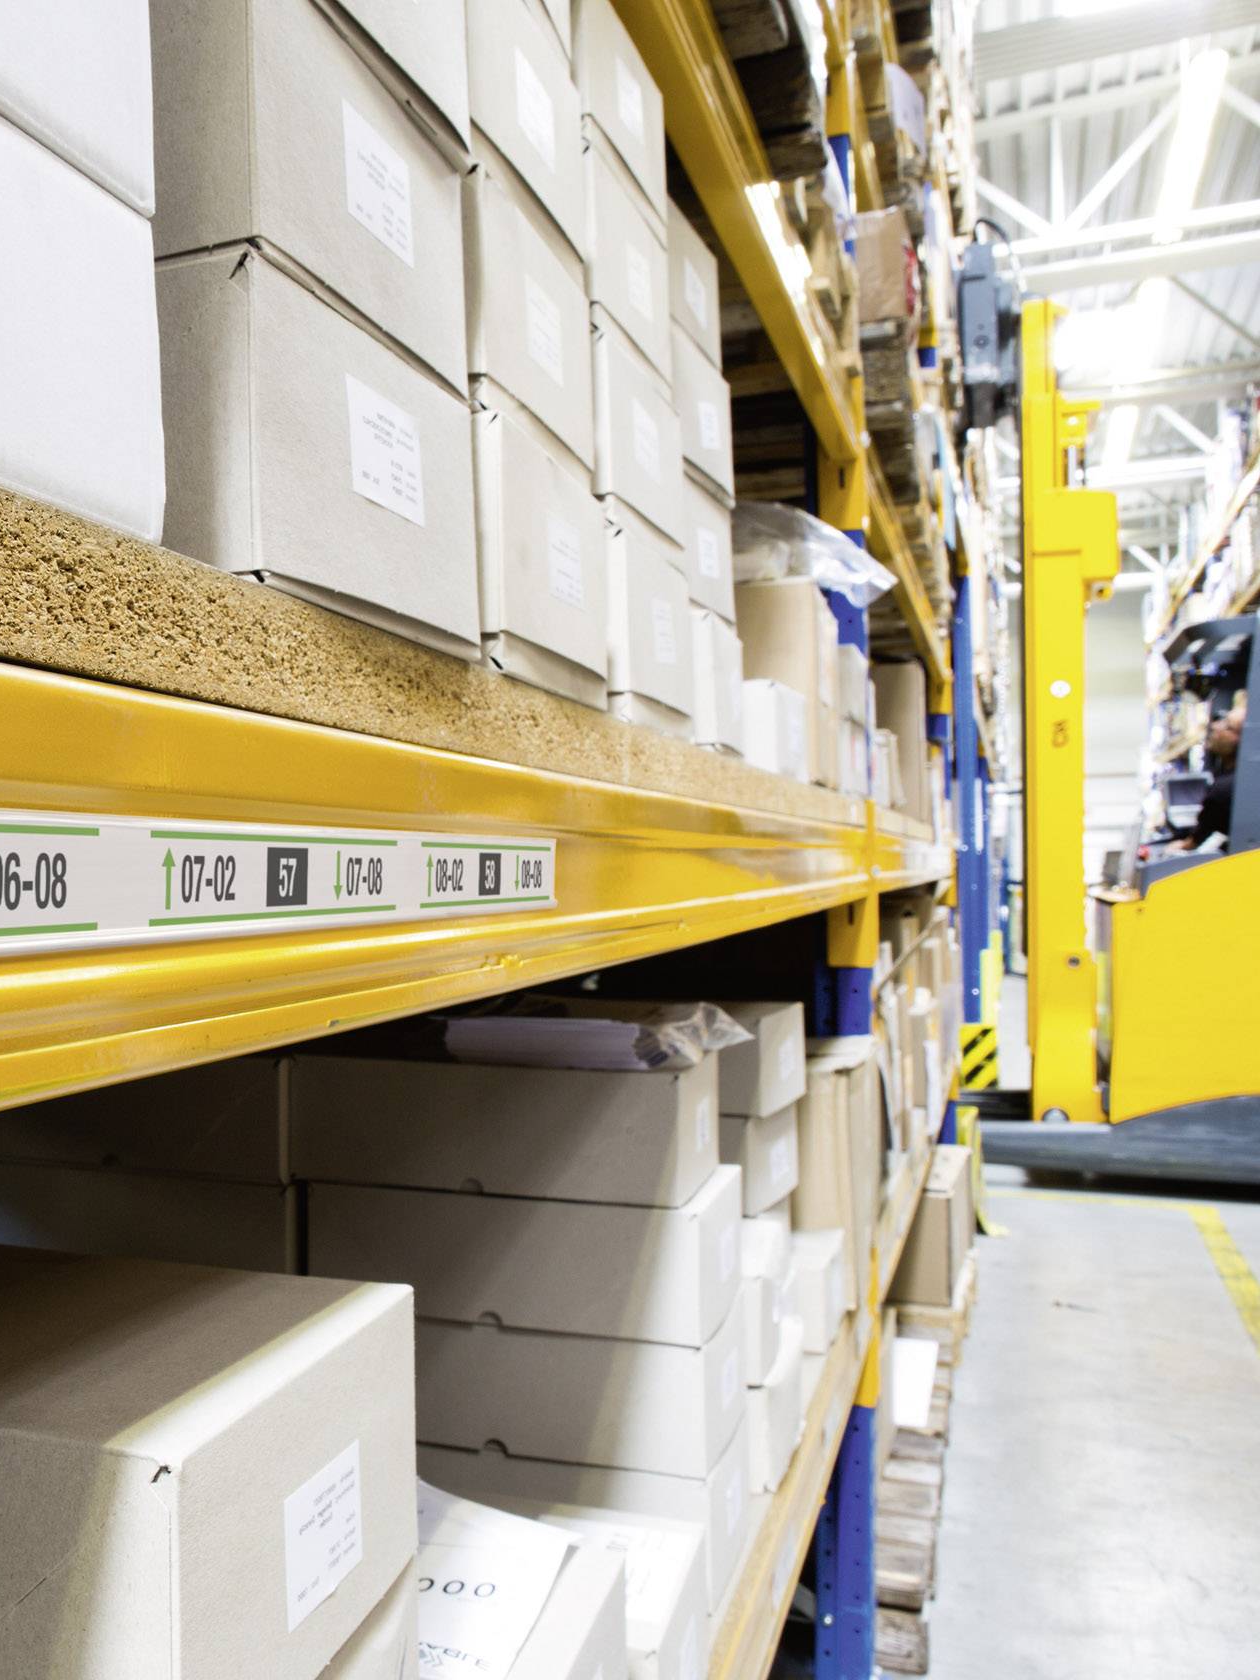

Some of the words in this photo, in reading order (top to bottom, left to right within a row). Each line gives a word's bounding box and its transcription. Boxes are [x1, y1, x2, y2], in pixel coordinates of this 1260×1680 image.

[181, 855, 236, 903] 07-02
[278, 857, 297, 898] 57
[346, 857, 383, 896] 07-08
[435, 858, 464, 892] 08-02
[484, 860, 496, 889] 58
[521, 860, 542, 888] 08-08
